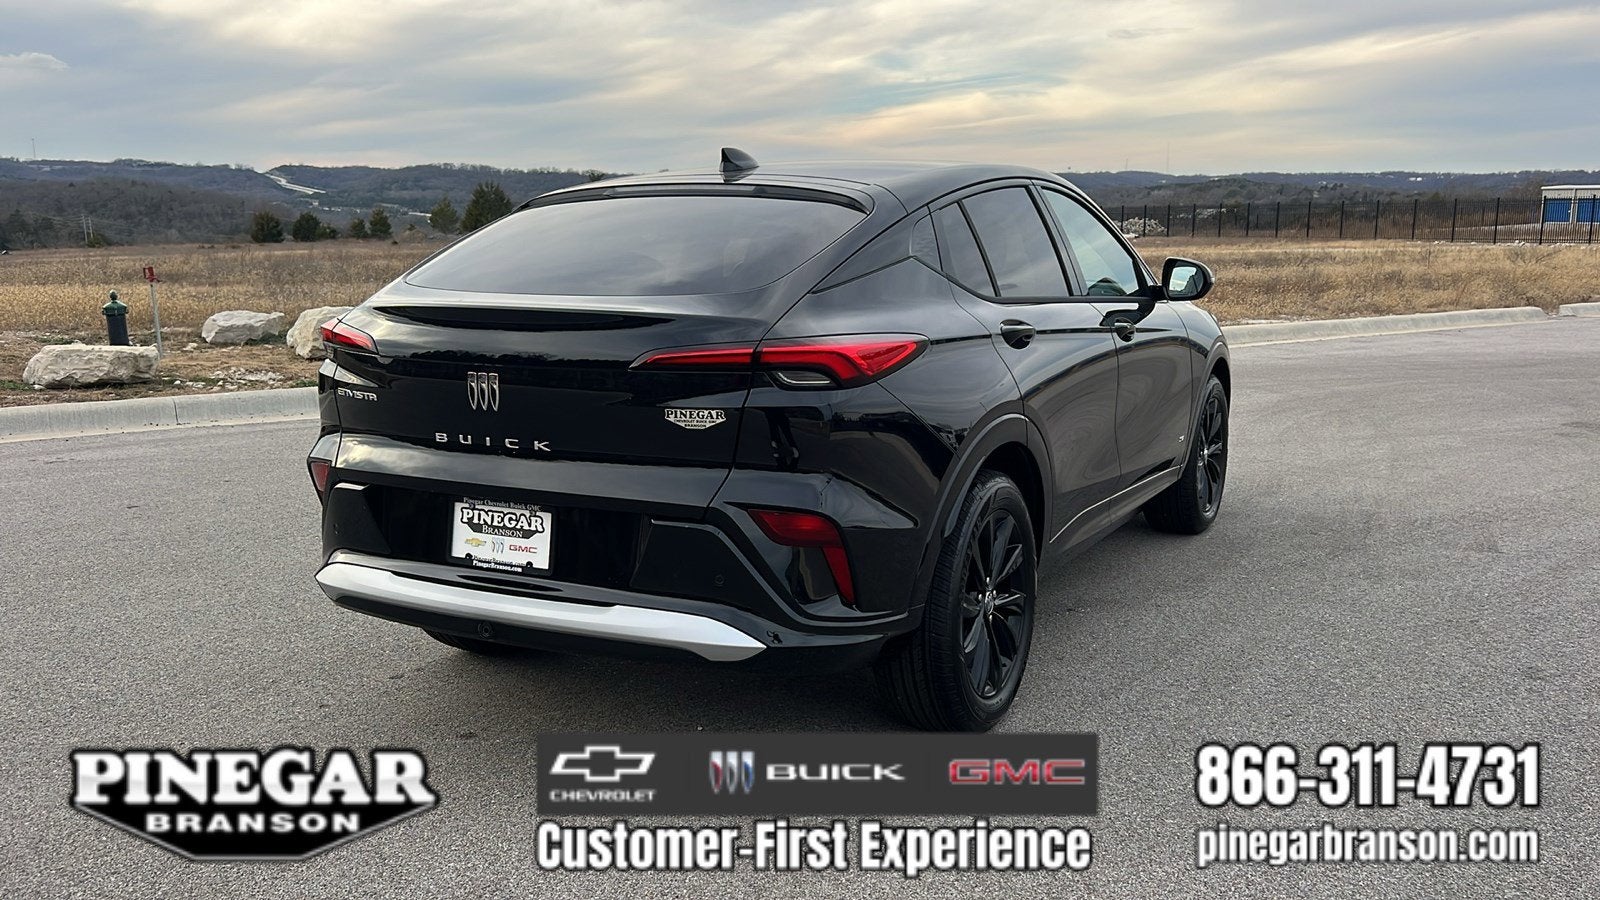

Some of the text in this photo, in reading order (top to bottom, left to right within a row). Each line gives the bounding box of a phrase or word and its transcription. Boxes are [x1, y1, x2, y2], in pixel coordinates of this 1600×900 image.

[665, 409, 726, 420] PINEGAR
[435, 432, 551, 452] BUICK
[484, 499, 509, 508] Chevrolet
[461, 508, 544, 532] PINEGAR
[482, 525, 523, 538] BRANSON
[509, 545, 538, 554] GMC
